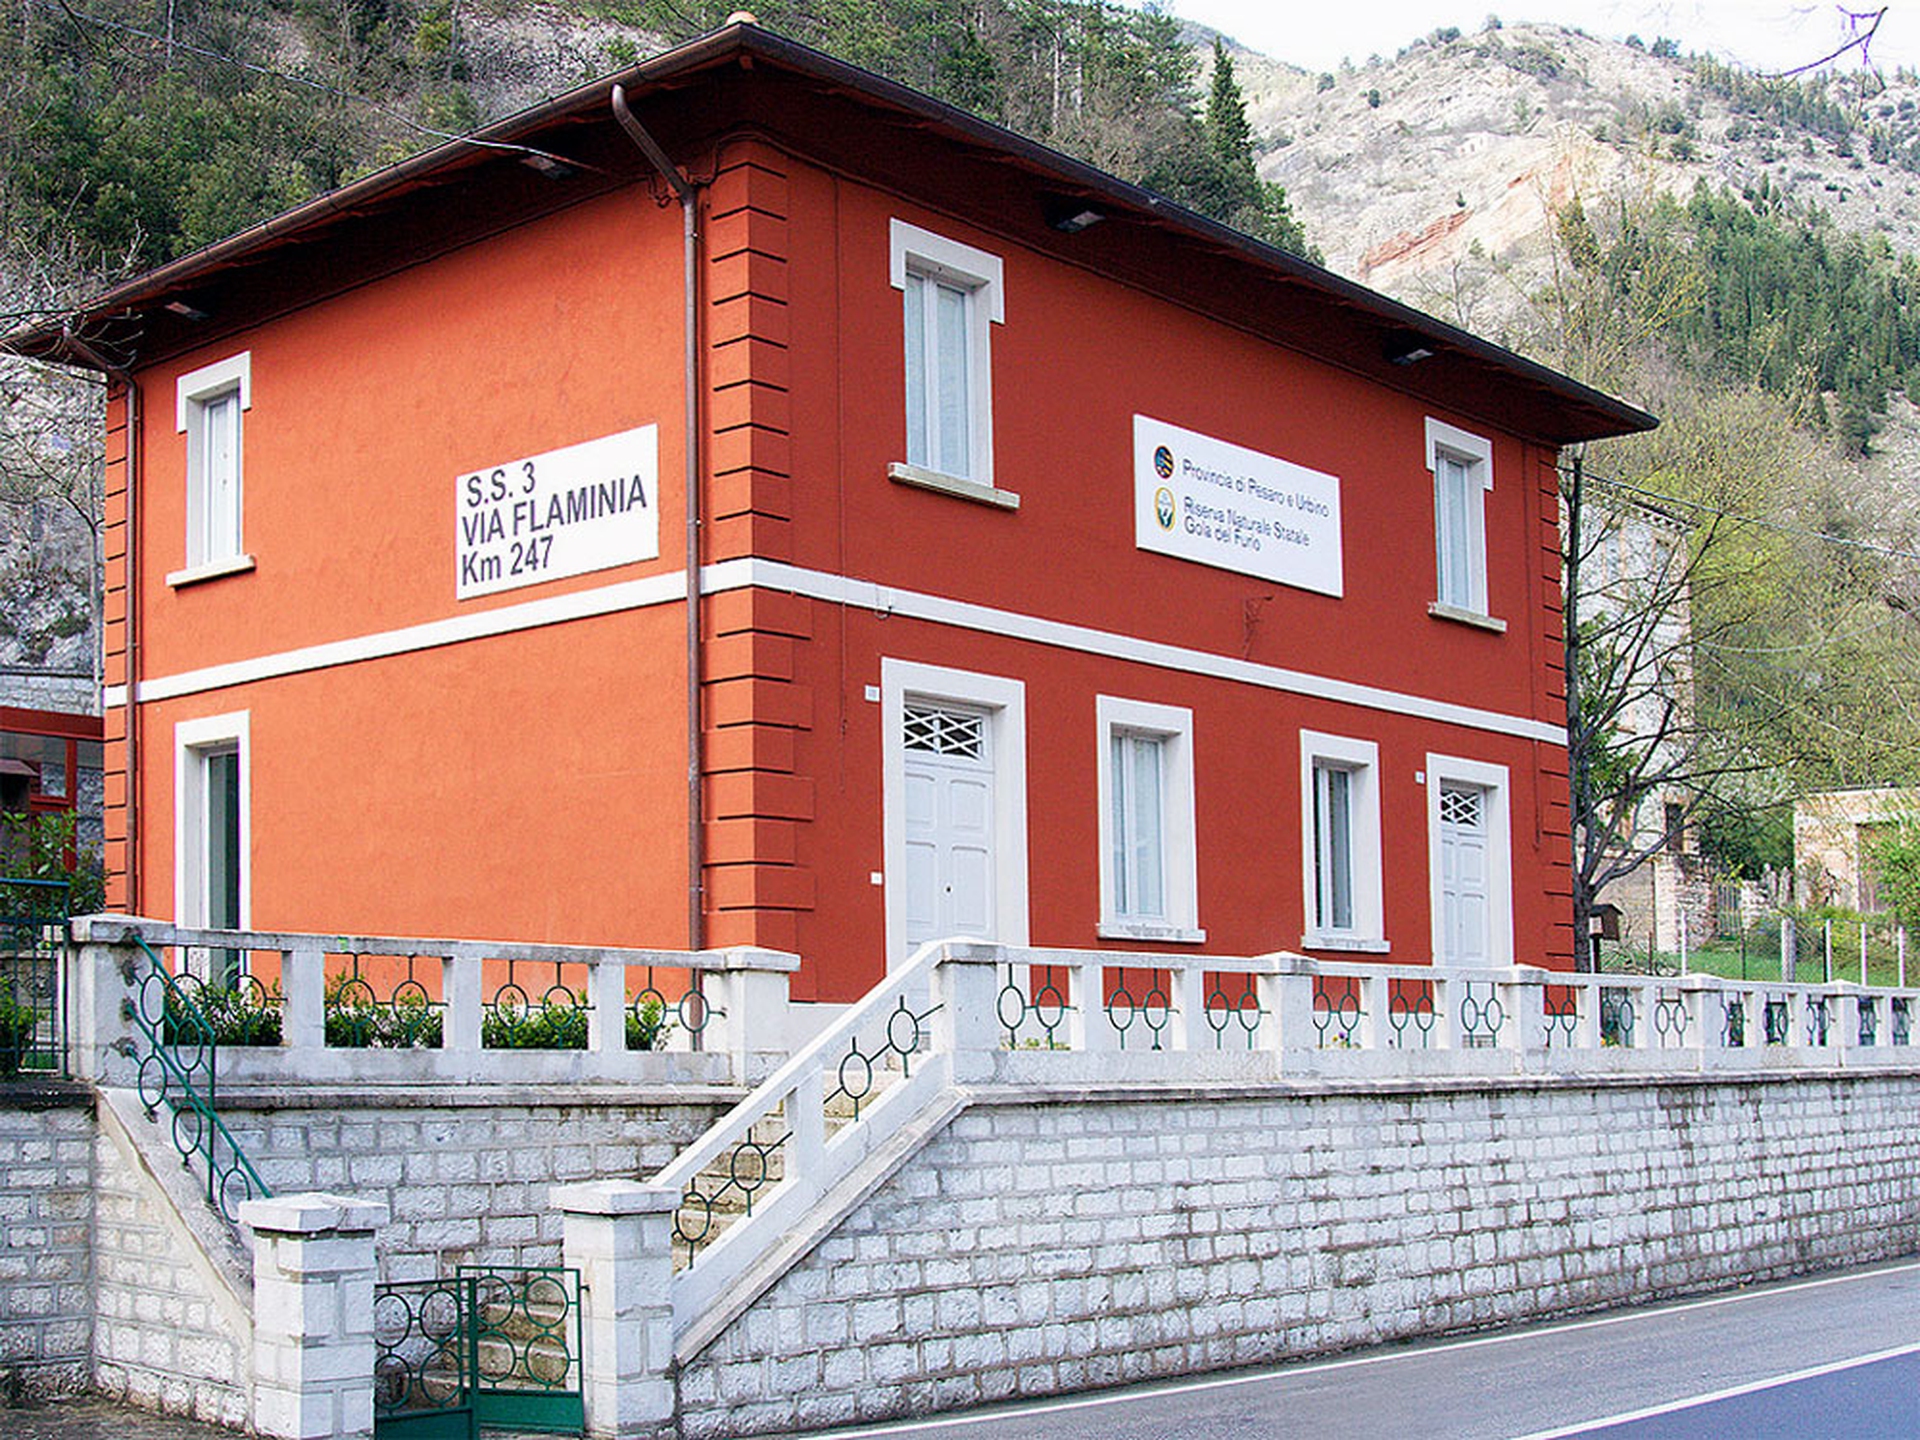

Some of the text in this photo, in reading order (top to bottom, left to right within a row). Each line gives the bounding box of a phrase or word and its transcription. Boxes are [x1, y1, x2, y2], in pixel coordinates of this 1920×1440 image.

[467, 461, 536, 508] S.S. 3
[1182, 459, 1233, 490] Provincia
[1248, 478, 1285, 505] Pesaro
[1287, 494, 1293, 508] e
[1295, 493, 1329, 518] Urbino
[462, 474, 647, 547] VIA FLAMINIA
[1183, 496, 1225, 524] Riserva
[1227, 508, 1271, 537] Naturale
[1183, 515, 1212, 538] Gola
[462, 534, 554, 587] Km 247
